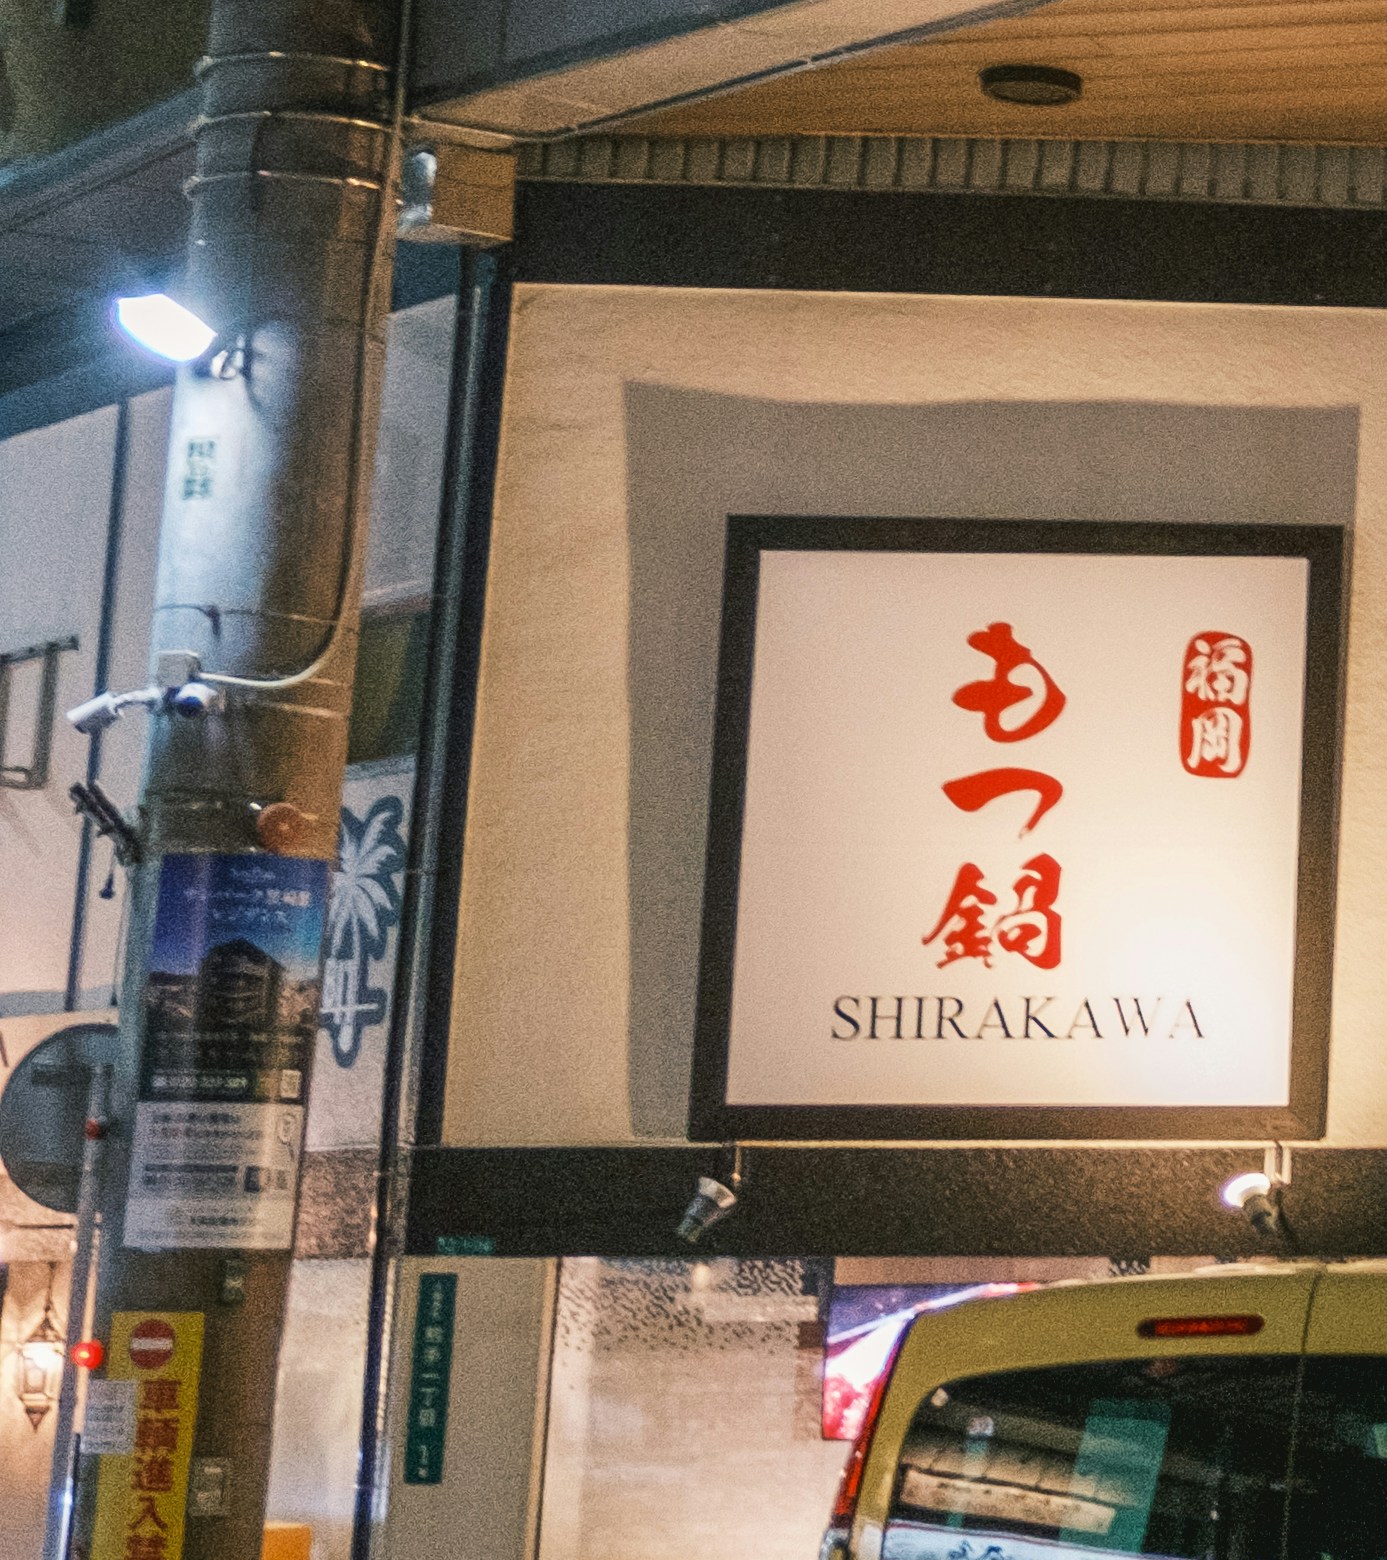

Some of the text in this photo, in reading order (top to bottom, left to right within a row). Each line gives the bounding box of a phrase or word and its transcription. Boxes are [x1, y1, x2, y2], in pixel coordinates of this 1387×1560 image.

[1182, 635, 1251, 774] 福岡
[921, 622, 1067, 970] もつ鍋
[829, 995, 1205, 1041] SHIRAKAWA
